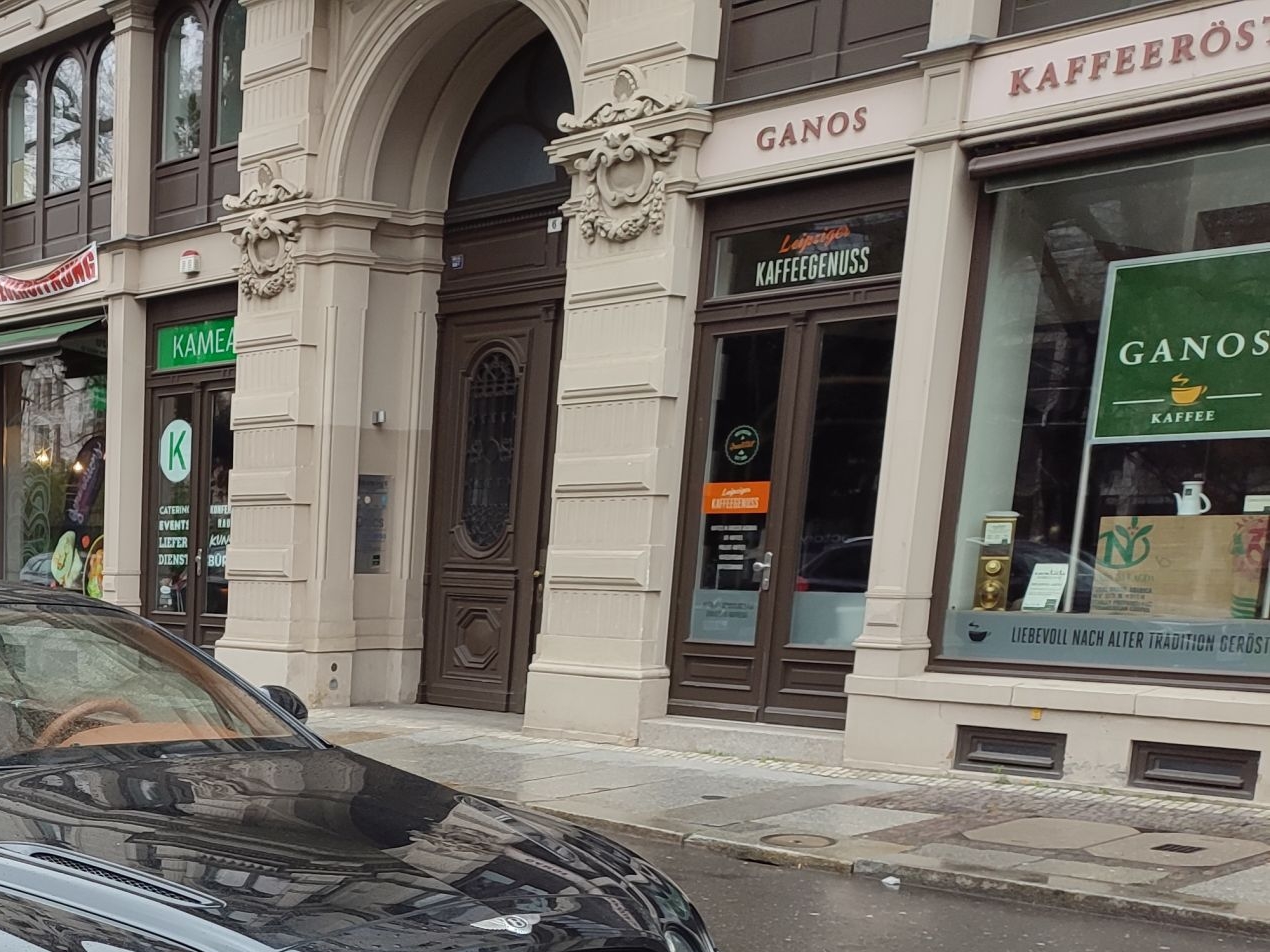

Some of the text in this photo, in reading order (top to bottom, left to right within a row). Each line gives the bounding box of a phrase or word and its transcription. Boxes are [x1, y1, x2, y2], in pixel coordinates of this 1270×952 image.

[756, 106, 868, 152] GANOS
[779, 224, 851, 253] Leipziger
[755, 246, 870, 287] KAFFEEGENUSS
[1118, 329, 1270, 366] GANOS
[1151, 410, 1215, 424] KAFFEE
[169, 430, 187, 471] K
[1011, 626, 1067, 646] LIEBEVOLL
[1072, 629, 1104, 647] NACH
[1108, 630, 1143, 649] ALTER
[1148, 632, 1214, 652] TRADITION
